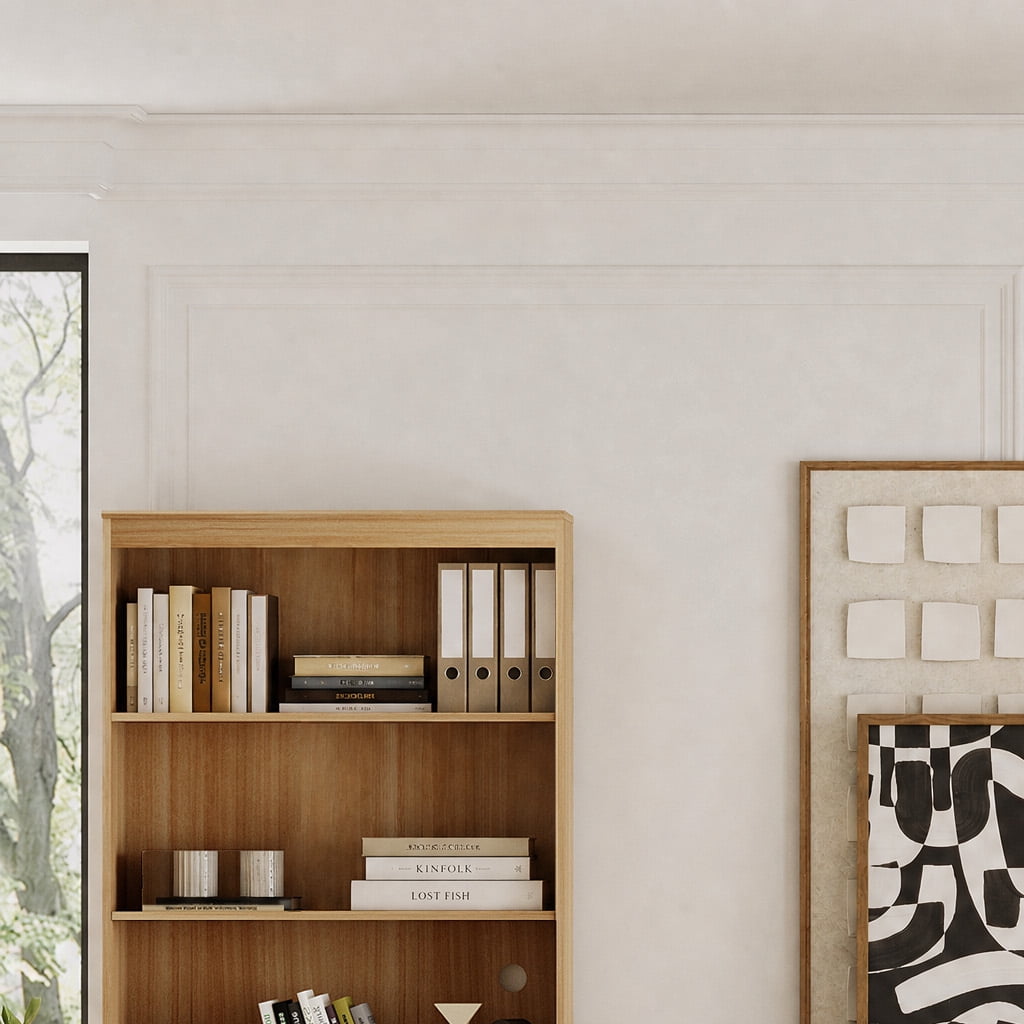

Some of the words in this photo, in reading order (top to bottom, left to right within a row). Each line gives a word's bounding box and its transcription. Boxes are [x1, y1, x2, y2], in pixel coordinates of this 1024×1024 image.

[416, 864, 472, 873] KINFOLK
[411, 891, 441, 901] LOST
[444, 891, 470, 901] FISH
